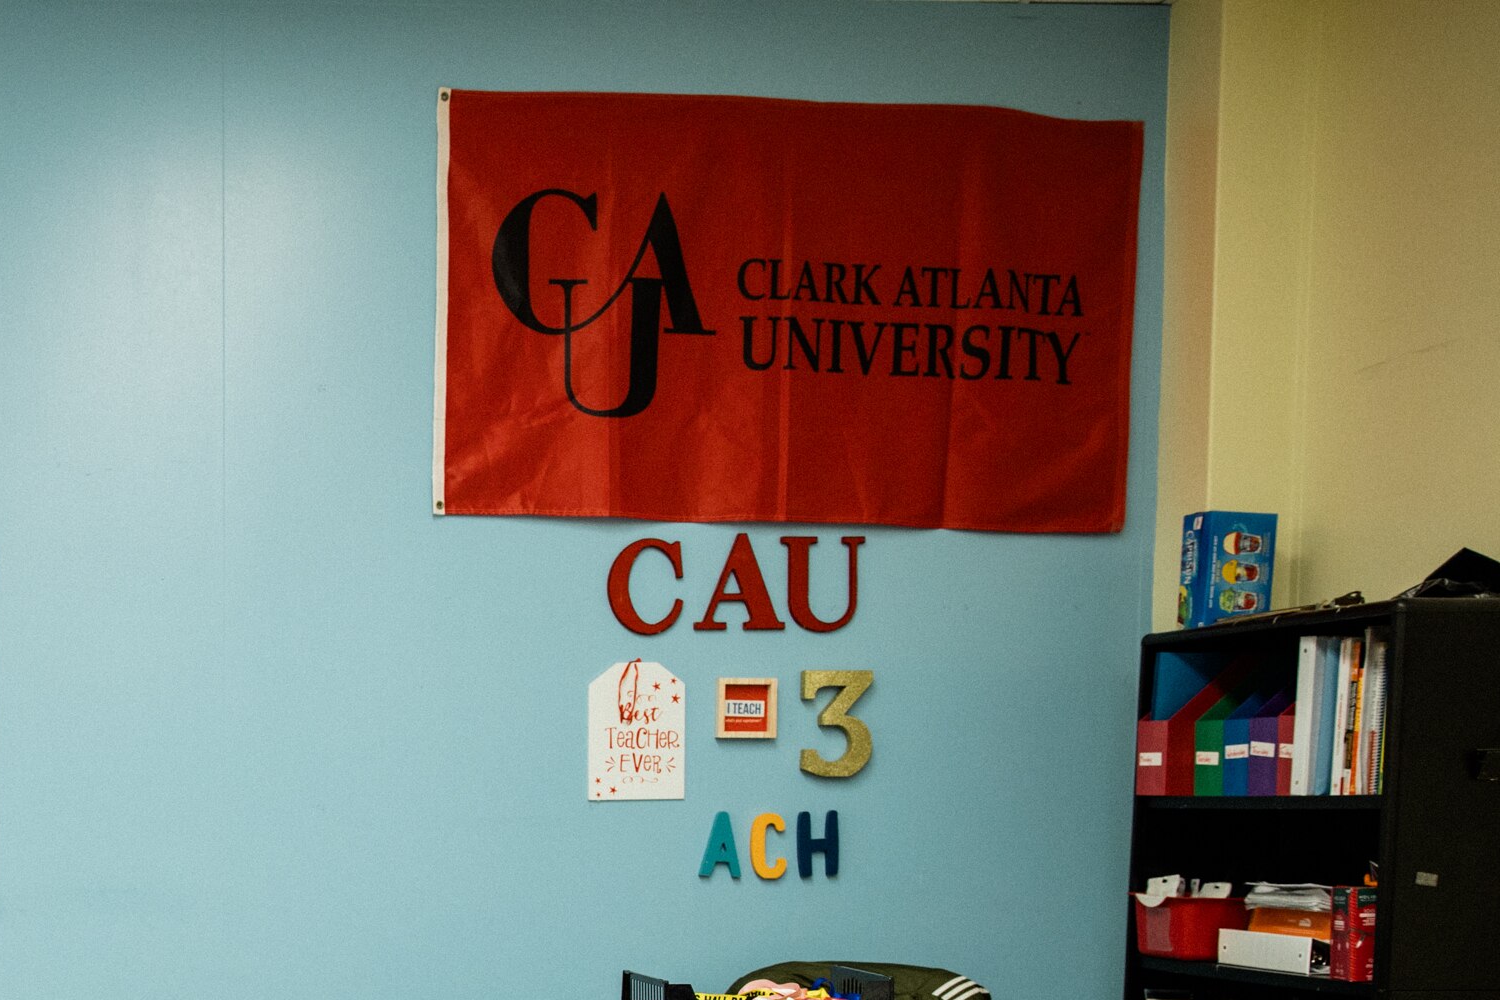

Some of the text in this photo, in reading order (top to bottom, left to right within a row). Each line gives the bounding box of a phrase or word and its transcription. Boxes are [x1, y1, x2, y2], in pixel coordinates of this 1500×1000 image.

[736, 256, 1084, 318] CLARK ATLANTA
[737, 315, 1083, 386] UNIVERSITY
[606, 532, 867, 636] CAU
[733, 702, 762, 715] TEACH
[799, 669, 874, 779] 3
[698, 809, 840, 880] ACH
